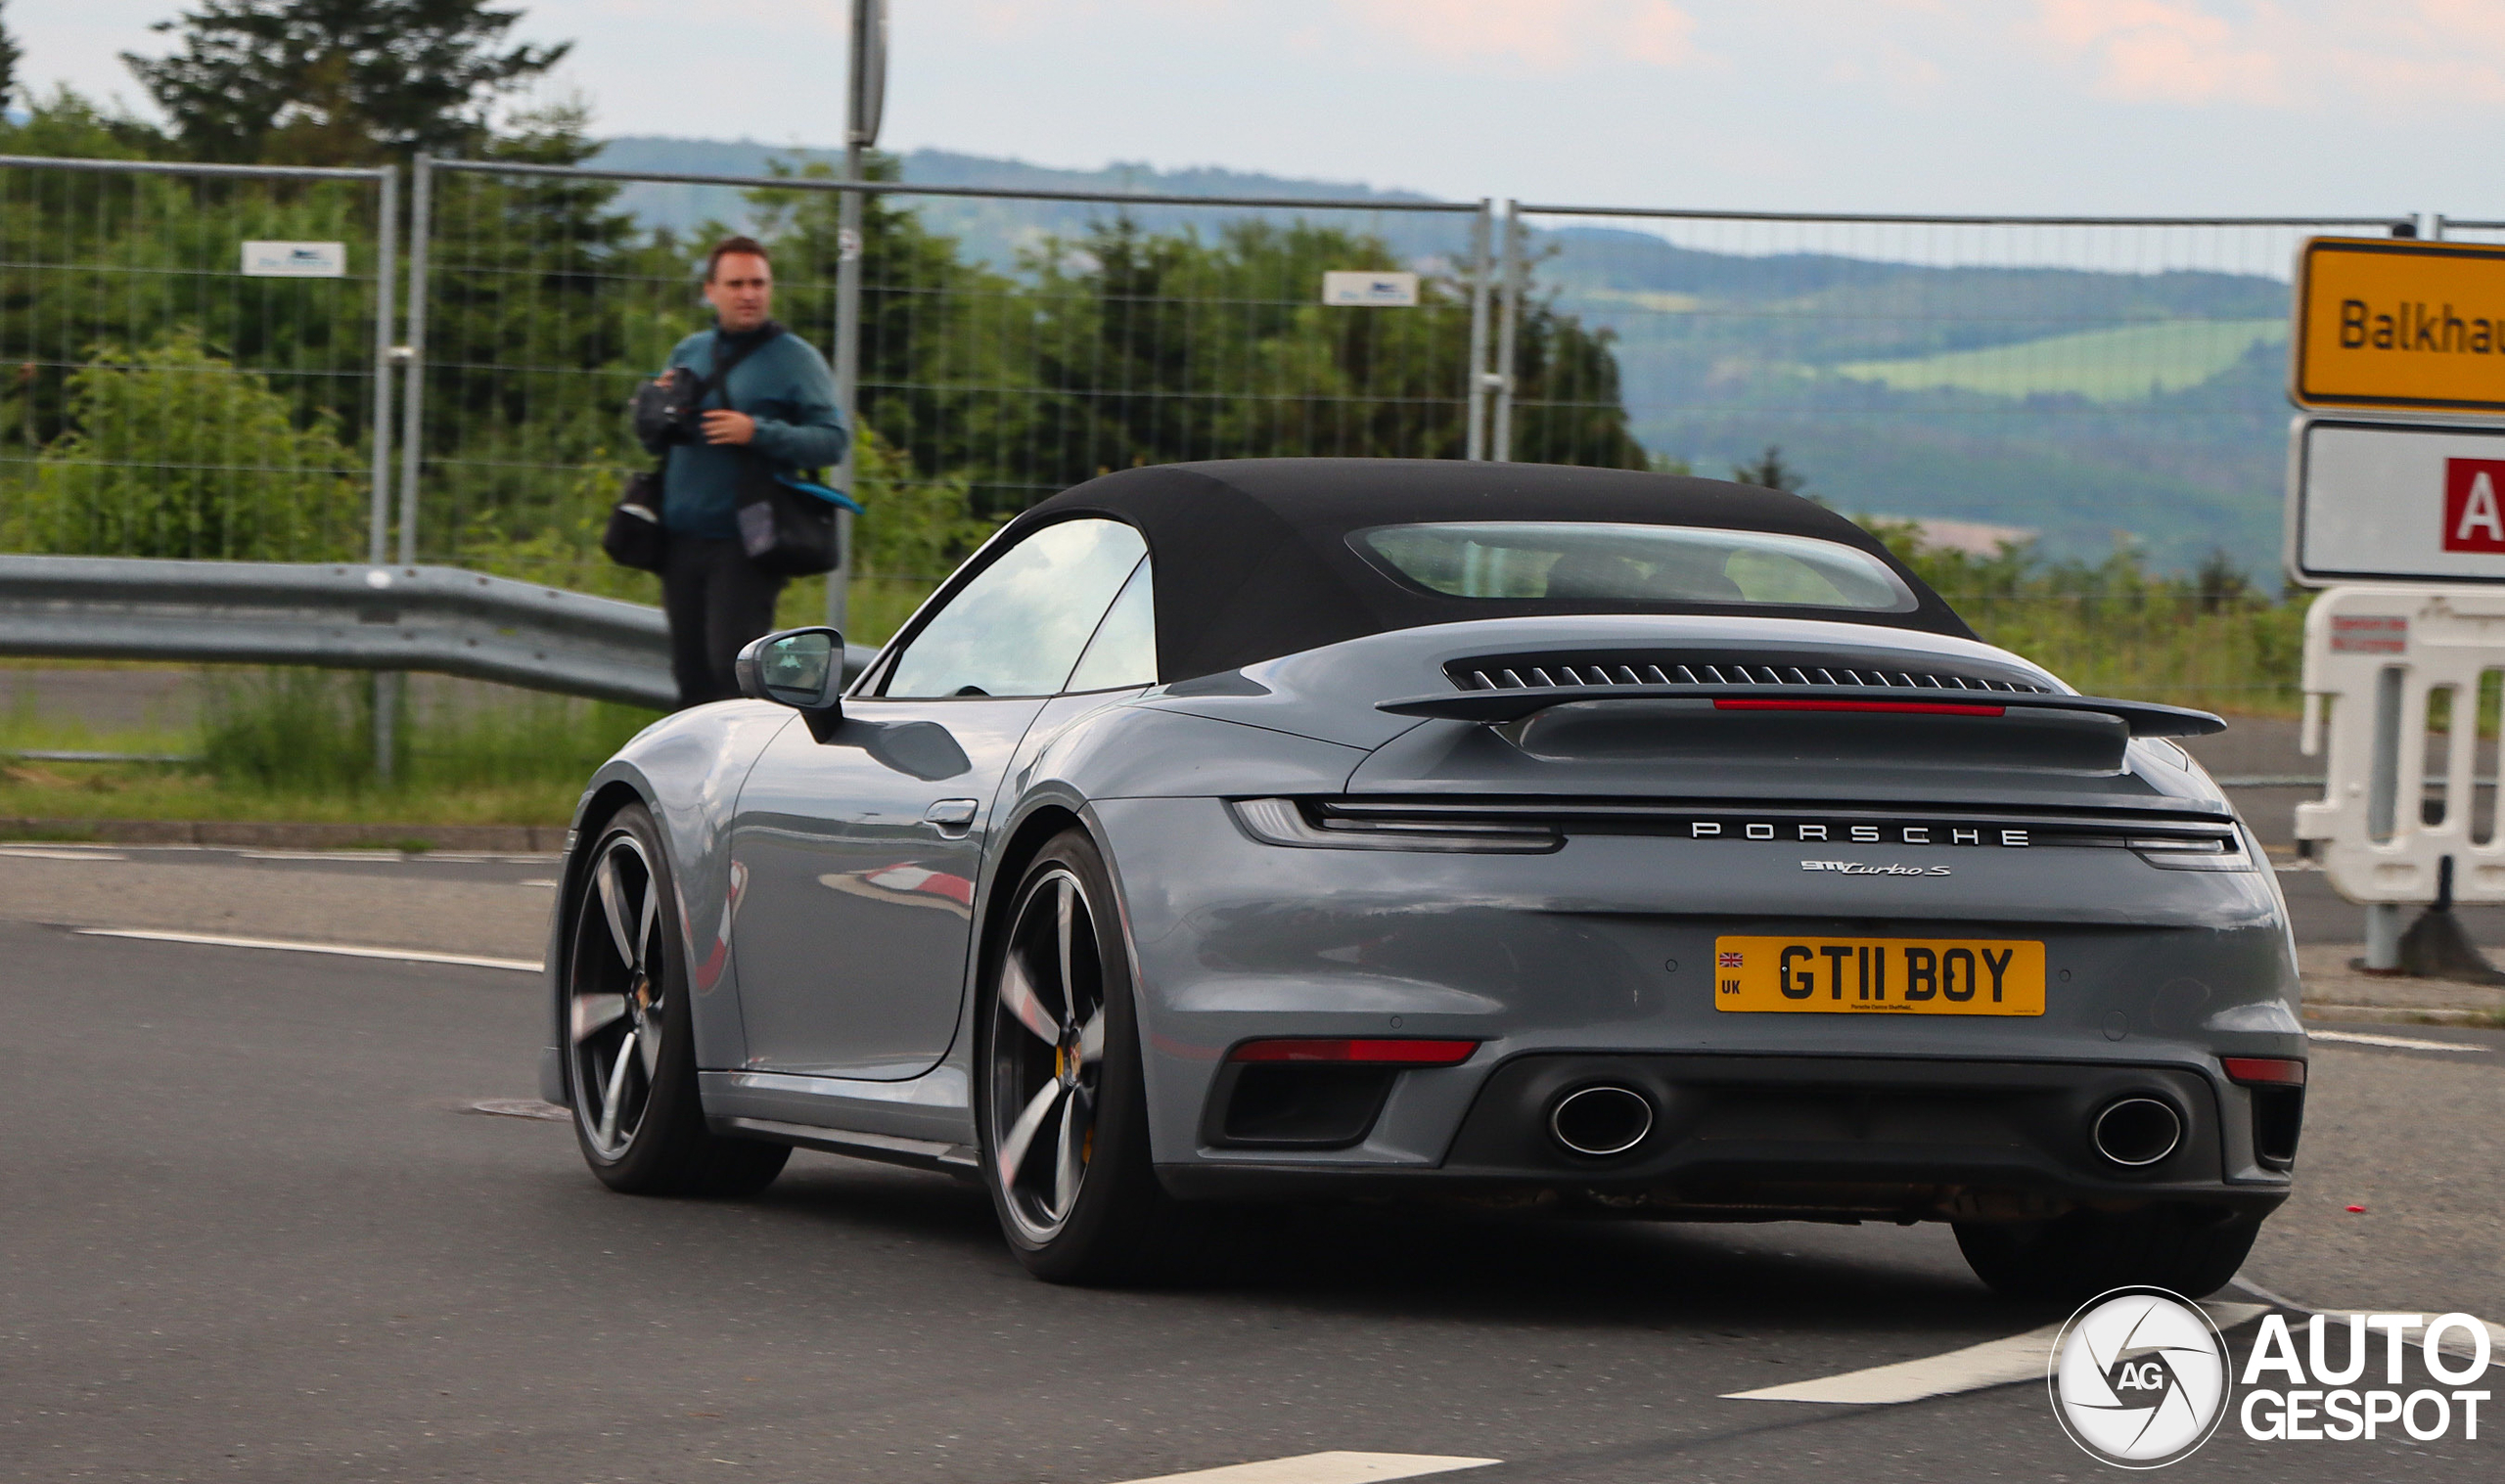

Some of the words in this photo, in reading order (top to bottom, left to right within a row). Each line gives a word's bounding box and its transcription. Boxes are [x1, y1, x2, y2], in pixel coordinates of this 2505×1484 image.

[2455, 472, 2505, 541] A
[1692, 822, 2029, 846] PORSCHE
[1925, 866, 1951, 877] S
[1904, 947, 2014, 1003] BOY
[1721, 980, 1741, 995] UK
